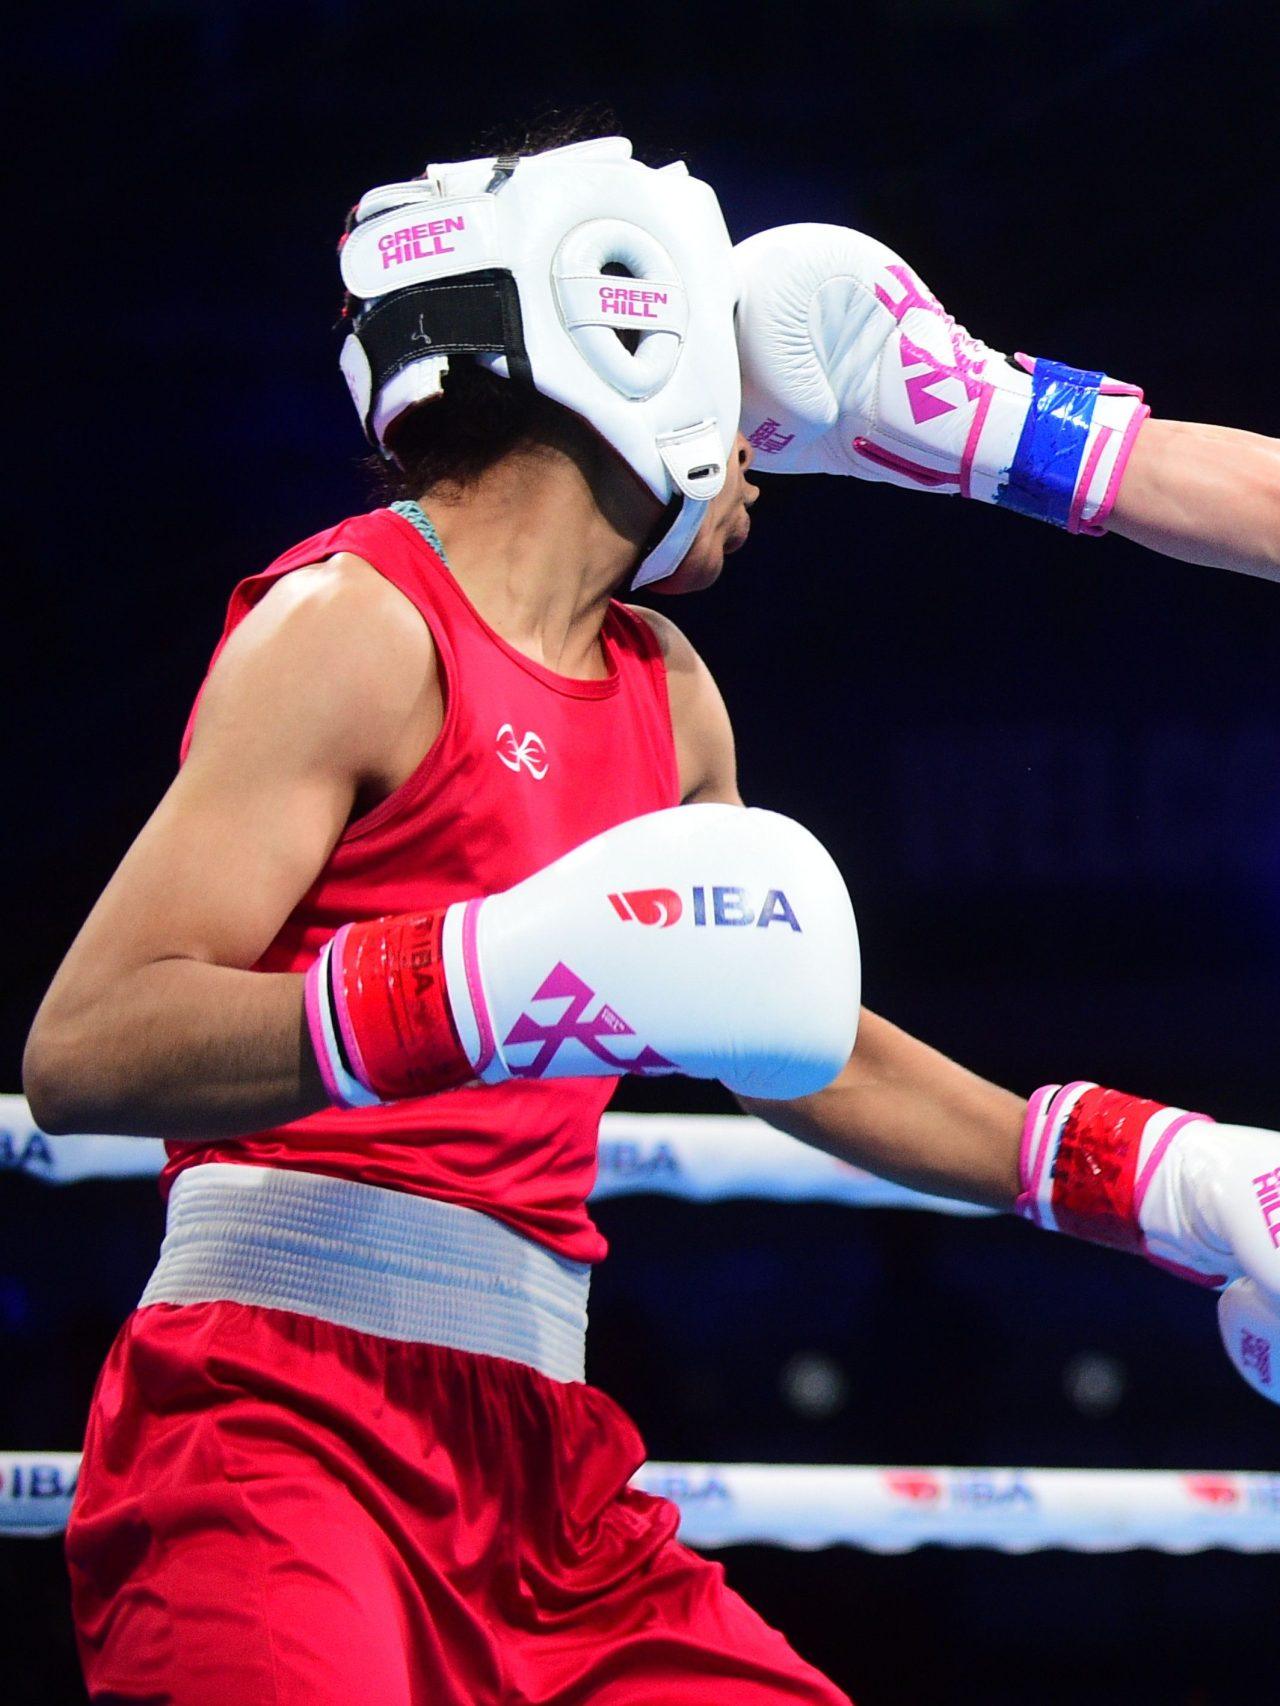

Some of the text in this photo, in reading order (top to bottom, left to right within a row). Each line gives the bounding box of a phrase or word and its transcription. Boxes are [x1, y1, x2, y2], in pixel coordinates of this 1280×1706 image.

[378, 216, 465, 251] GREEN
[382, 236, 455, 269] HILL
[598, 287, 668, 304] GREEN
[601, 299, 658, 318] HILL
[692, 886, 803, 933] IBA
